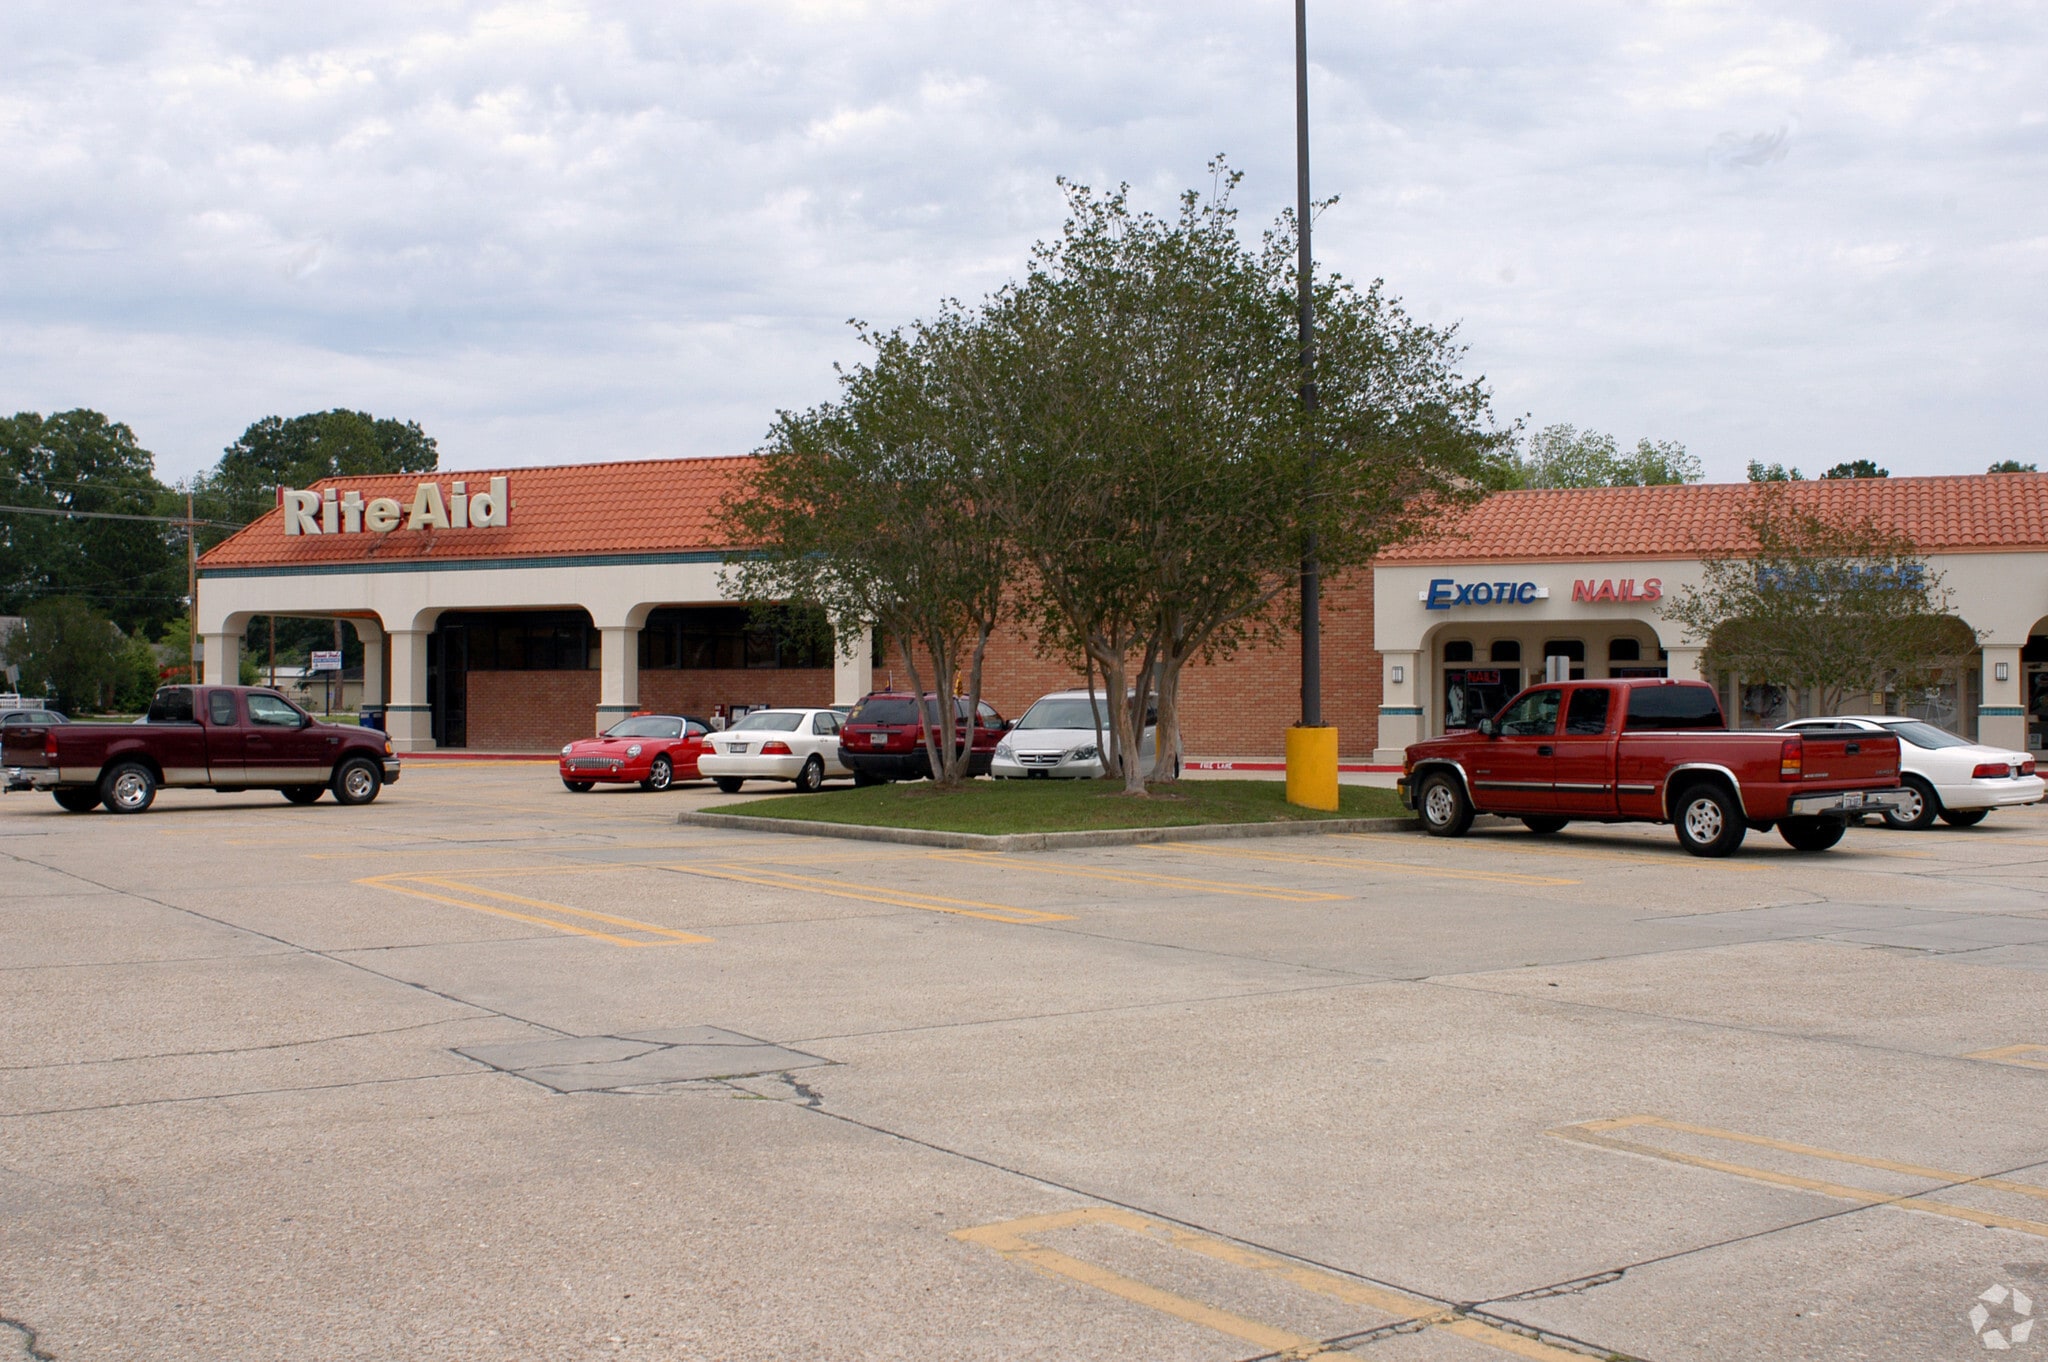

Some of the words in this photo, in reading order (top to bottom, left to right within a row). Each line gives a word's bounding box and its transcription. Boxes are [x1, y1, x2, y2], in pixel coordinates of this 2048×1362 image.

[282, 487, 401, 535] Rite
[407, 476, 511, 530] Aid
[1425, 579, 1537, 610] EXOTIC
[1571, 578, 1663, 602] NAILS
[1467, 671, 1498, 683] NAILS
